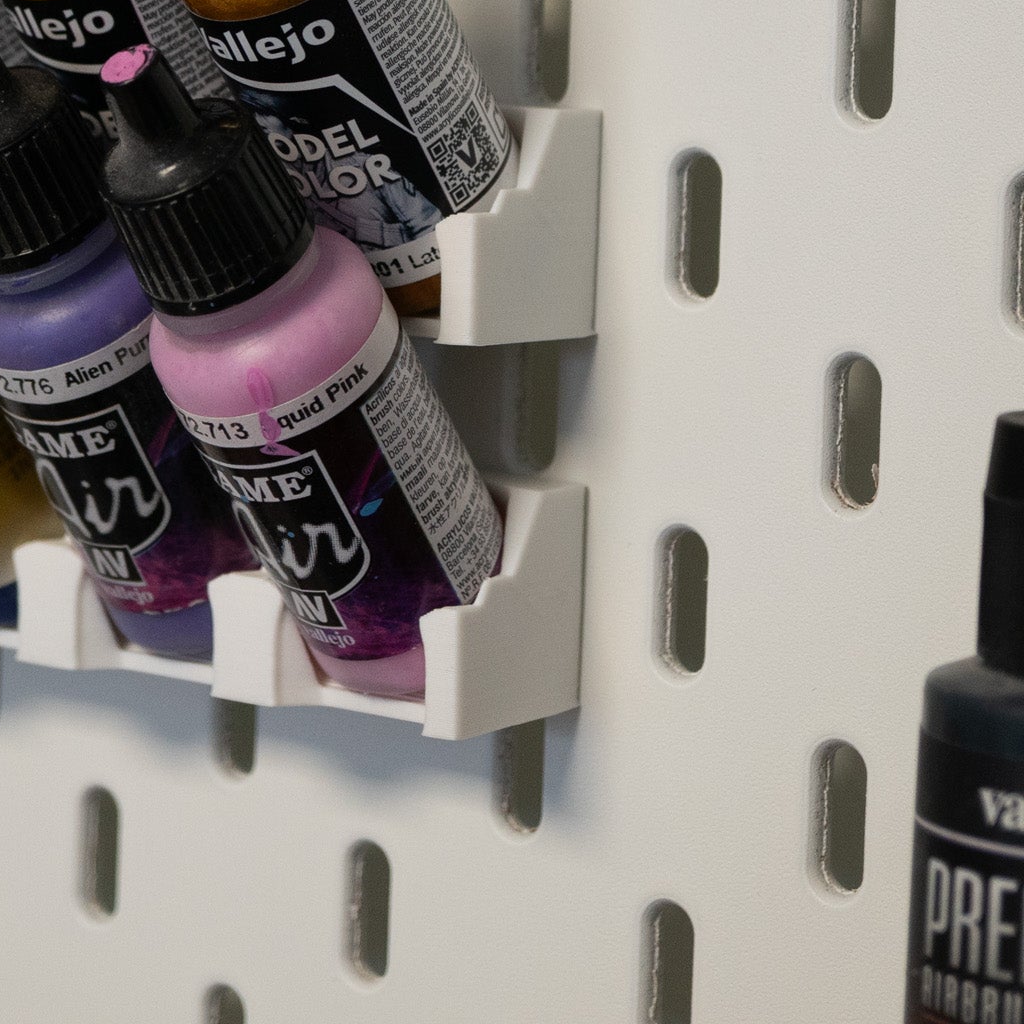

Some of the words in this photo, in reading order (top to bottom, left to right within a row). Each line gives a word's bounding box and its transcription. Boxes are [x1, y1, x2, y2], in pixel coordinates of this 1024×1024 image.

[362, 11, 377, 24] May
[380, 35, 407, 60] reaktion.
[383, 37, 418, 70] allergische
[408, 98, 427, 116] Made
[425, 91, 433, 101] in
[432, 77, 448, 97] Spain
[413, 101, 438, 125] Eusebio
[417, 114, 438, 134] 08800
[267, 119, 381, 164] ODEL
[371, 256, 404, 277] 01
[65, 361, 113, 388] Alien
[277, 394, 326, 429] quid
[326, 361, 369, 403] Pink
[369, 398, 394, 426] brush
[375, 417, 395, 437] ben,
[381, 426, 403, 448] base
[398, 415, 409, 429] di
[18, 426, 116, 458] AME
[386, 436, 409, 459] base
[404, 425, 416, 440] de
[392, 450, 412, 472] qua.
[216, 470, 313, 503] AME
[404, 465, 429, 492] maali
[409, 471, 440, 503] kleuren,
[414, 488, 440, 514] farve,
[420, 497, 445, 525] brush
[440, 534, 465, 561] 08800
[450, 565, 465, 580] Tel.
[926, 856, 1024, 982] PRE
